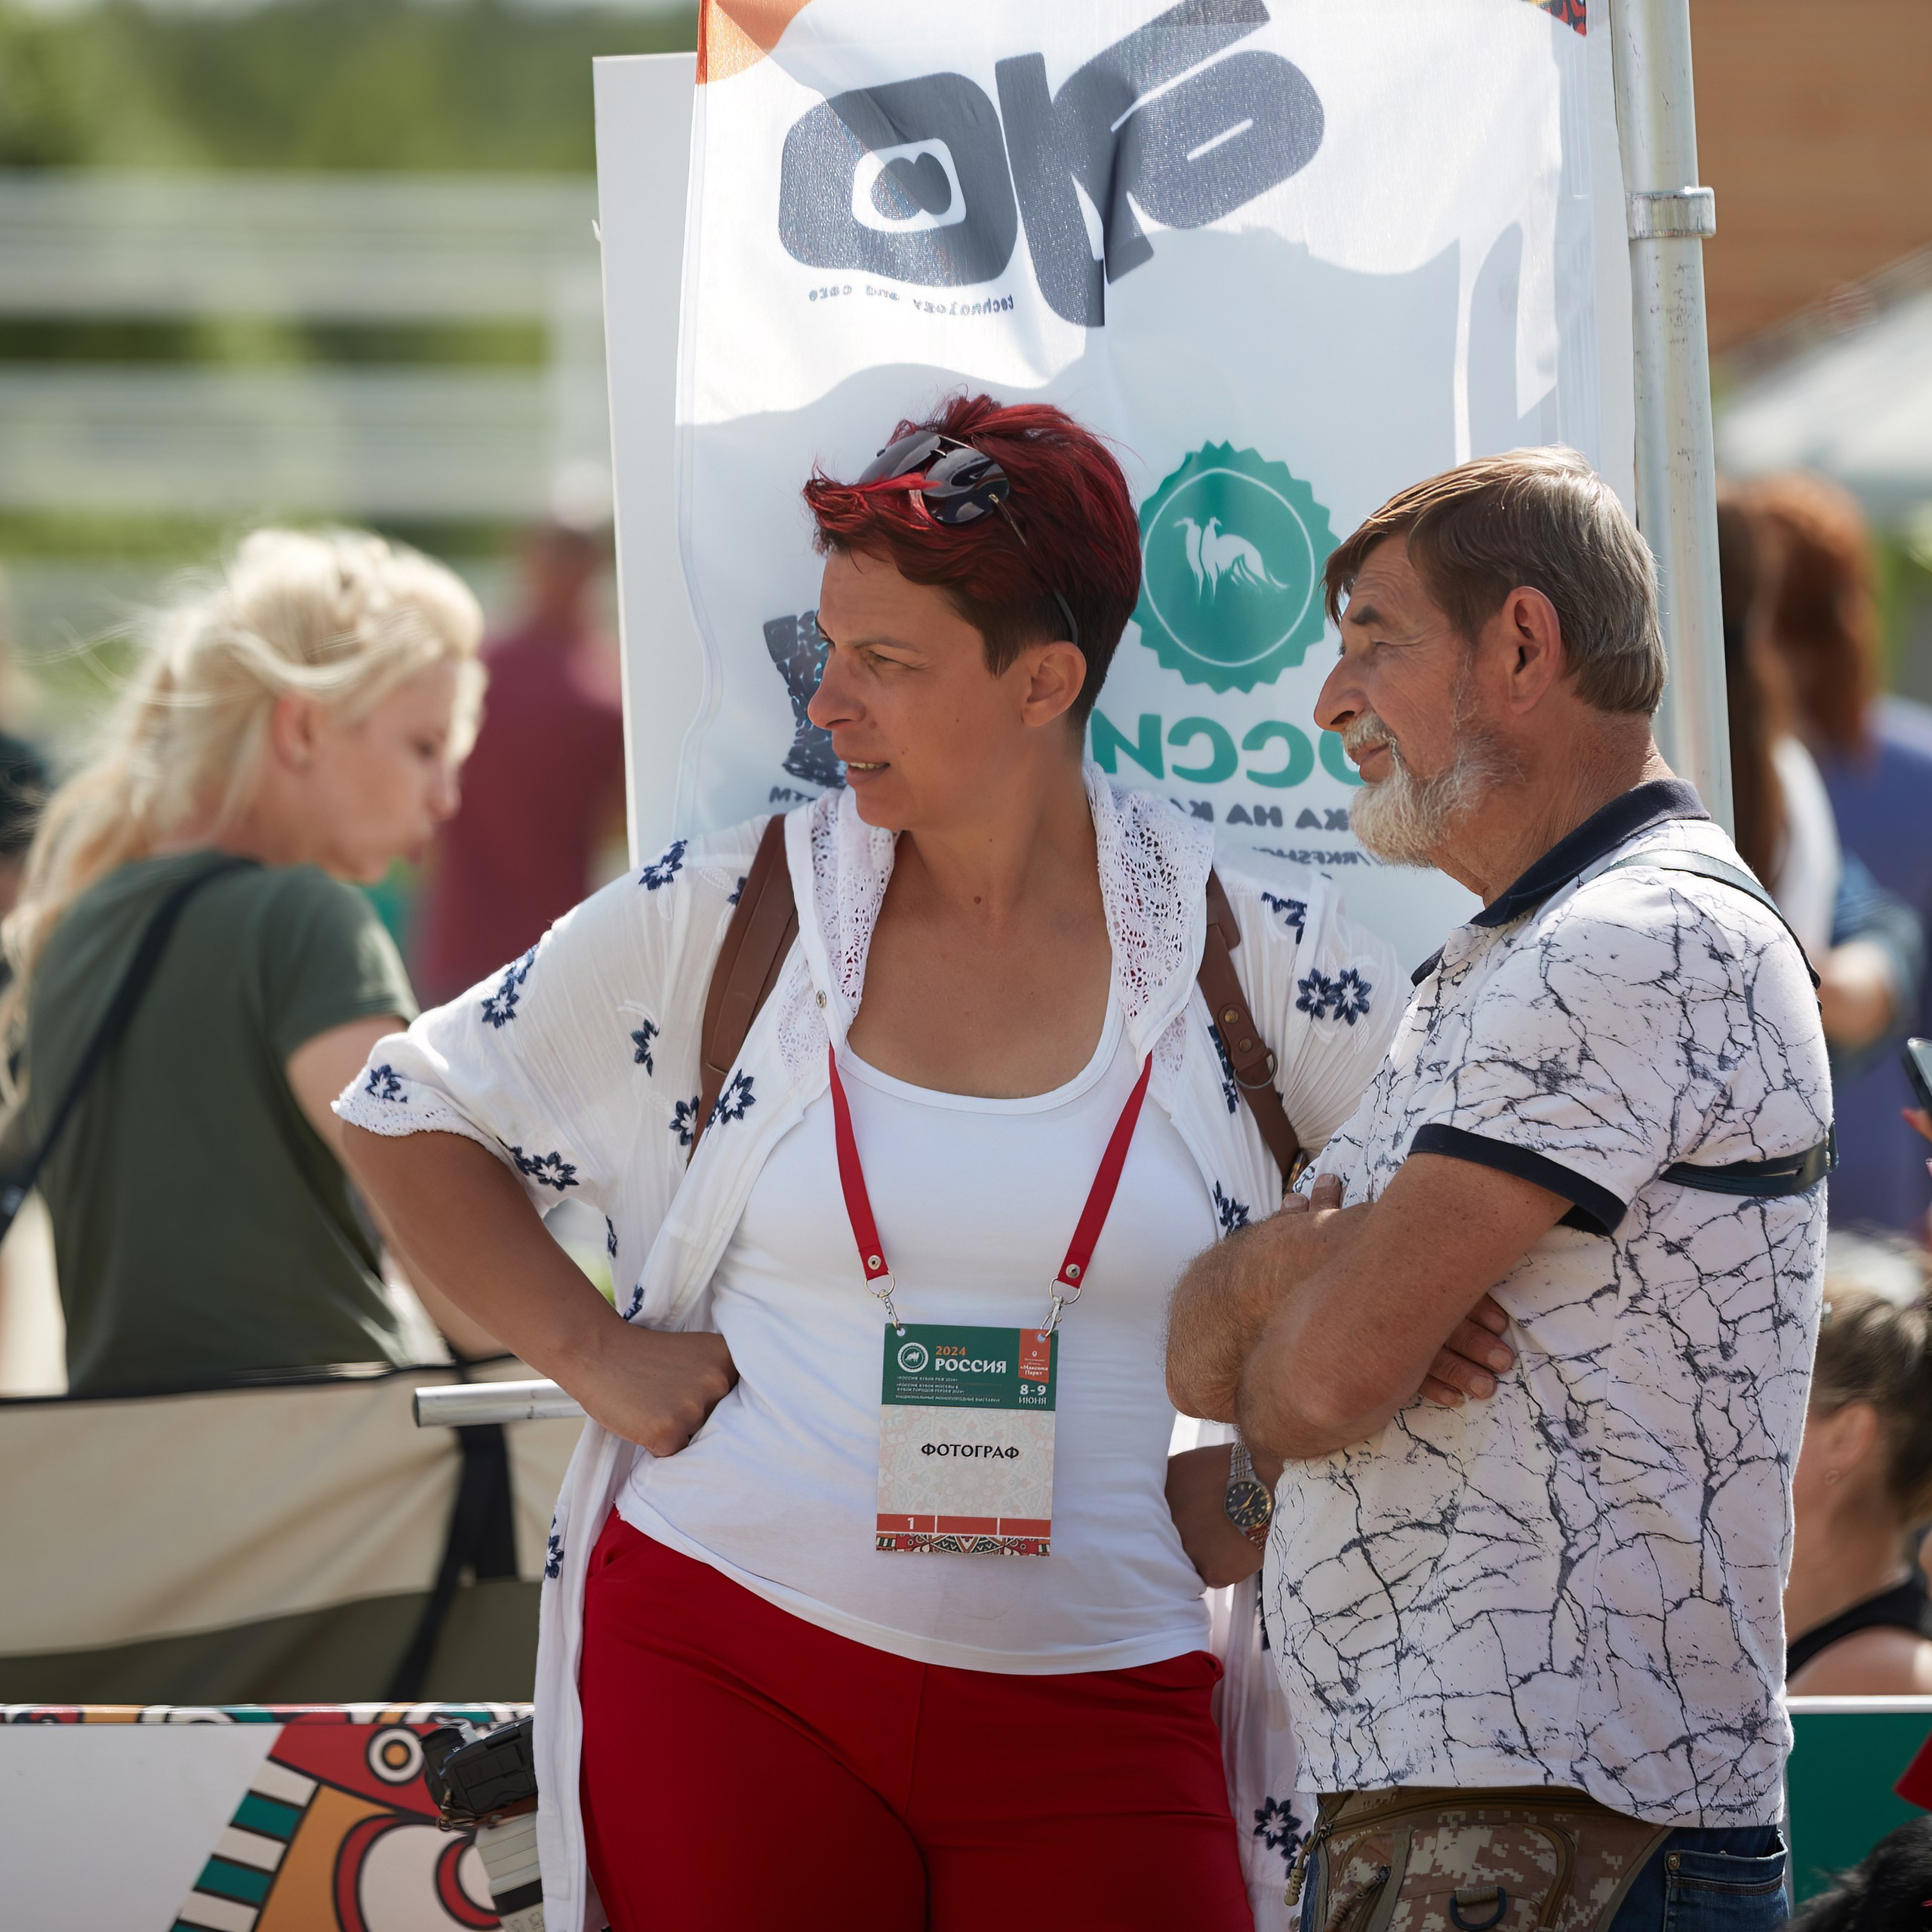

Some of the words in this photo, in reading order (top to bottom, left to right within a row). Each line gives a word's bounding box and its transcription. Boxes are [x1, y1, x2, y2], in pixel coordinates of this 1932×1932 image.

[935, 1346, 966, 1356] 2024
[934, 1358, 1008, 1374] РОССИЯ
[1018, 1396, 1047, 1405] ИЮНЯ
[921, 1442, 1020, 1459] ФОТОГРАФ
[907, 1517, 915, 1530] 1
